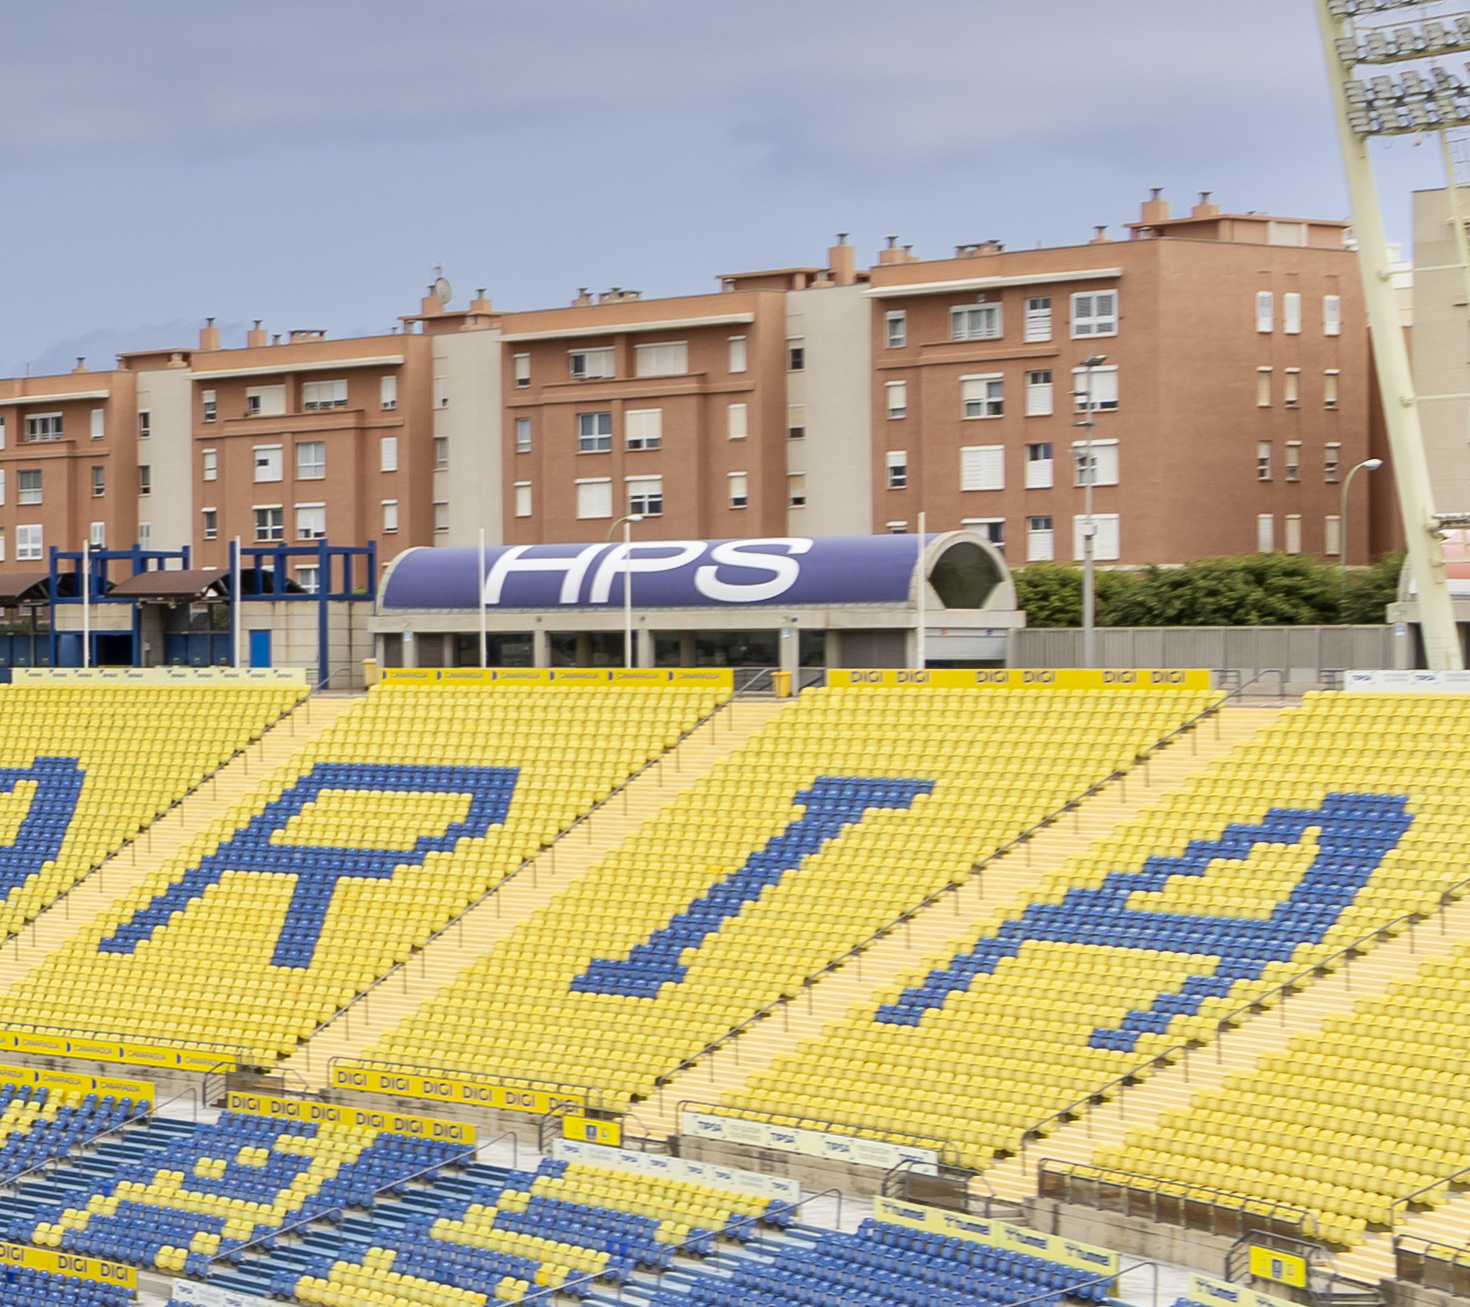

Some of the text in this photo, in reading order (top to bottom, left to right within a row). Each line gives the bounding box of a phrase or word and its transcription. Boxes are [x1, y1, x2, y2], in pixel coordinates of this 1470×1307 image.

[484, 538, 813, 603] HPS
[338, 1071, 367, 1086] DIGI
[380, 1076, 409, 1092] DIGI
[422, 1080, 452, 1097] DIGI
[463, 1085, 493, 1102] DIGI
[232, 1096, 261, 1112] DIGI
[505, 1091, 535, 1107] DIGI
[271, 1101, 300, 1116] DIGI
[311, 1106, 340, 1122] DIGI
[356, 1112, 385, 1128] DIGI
[395, 1117, 424, 1133] DIGI
[433, 1122, 463, 1140] DIGI
[57, 1255, 88, 1273] DIGI
[100, 1262, 129, 1280] DIGI
